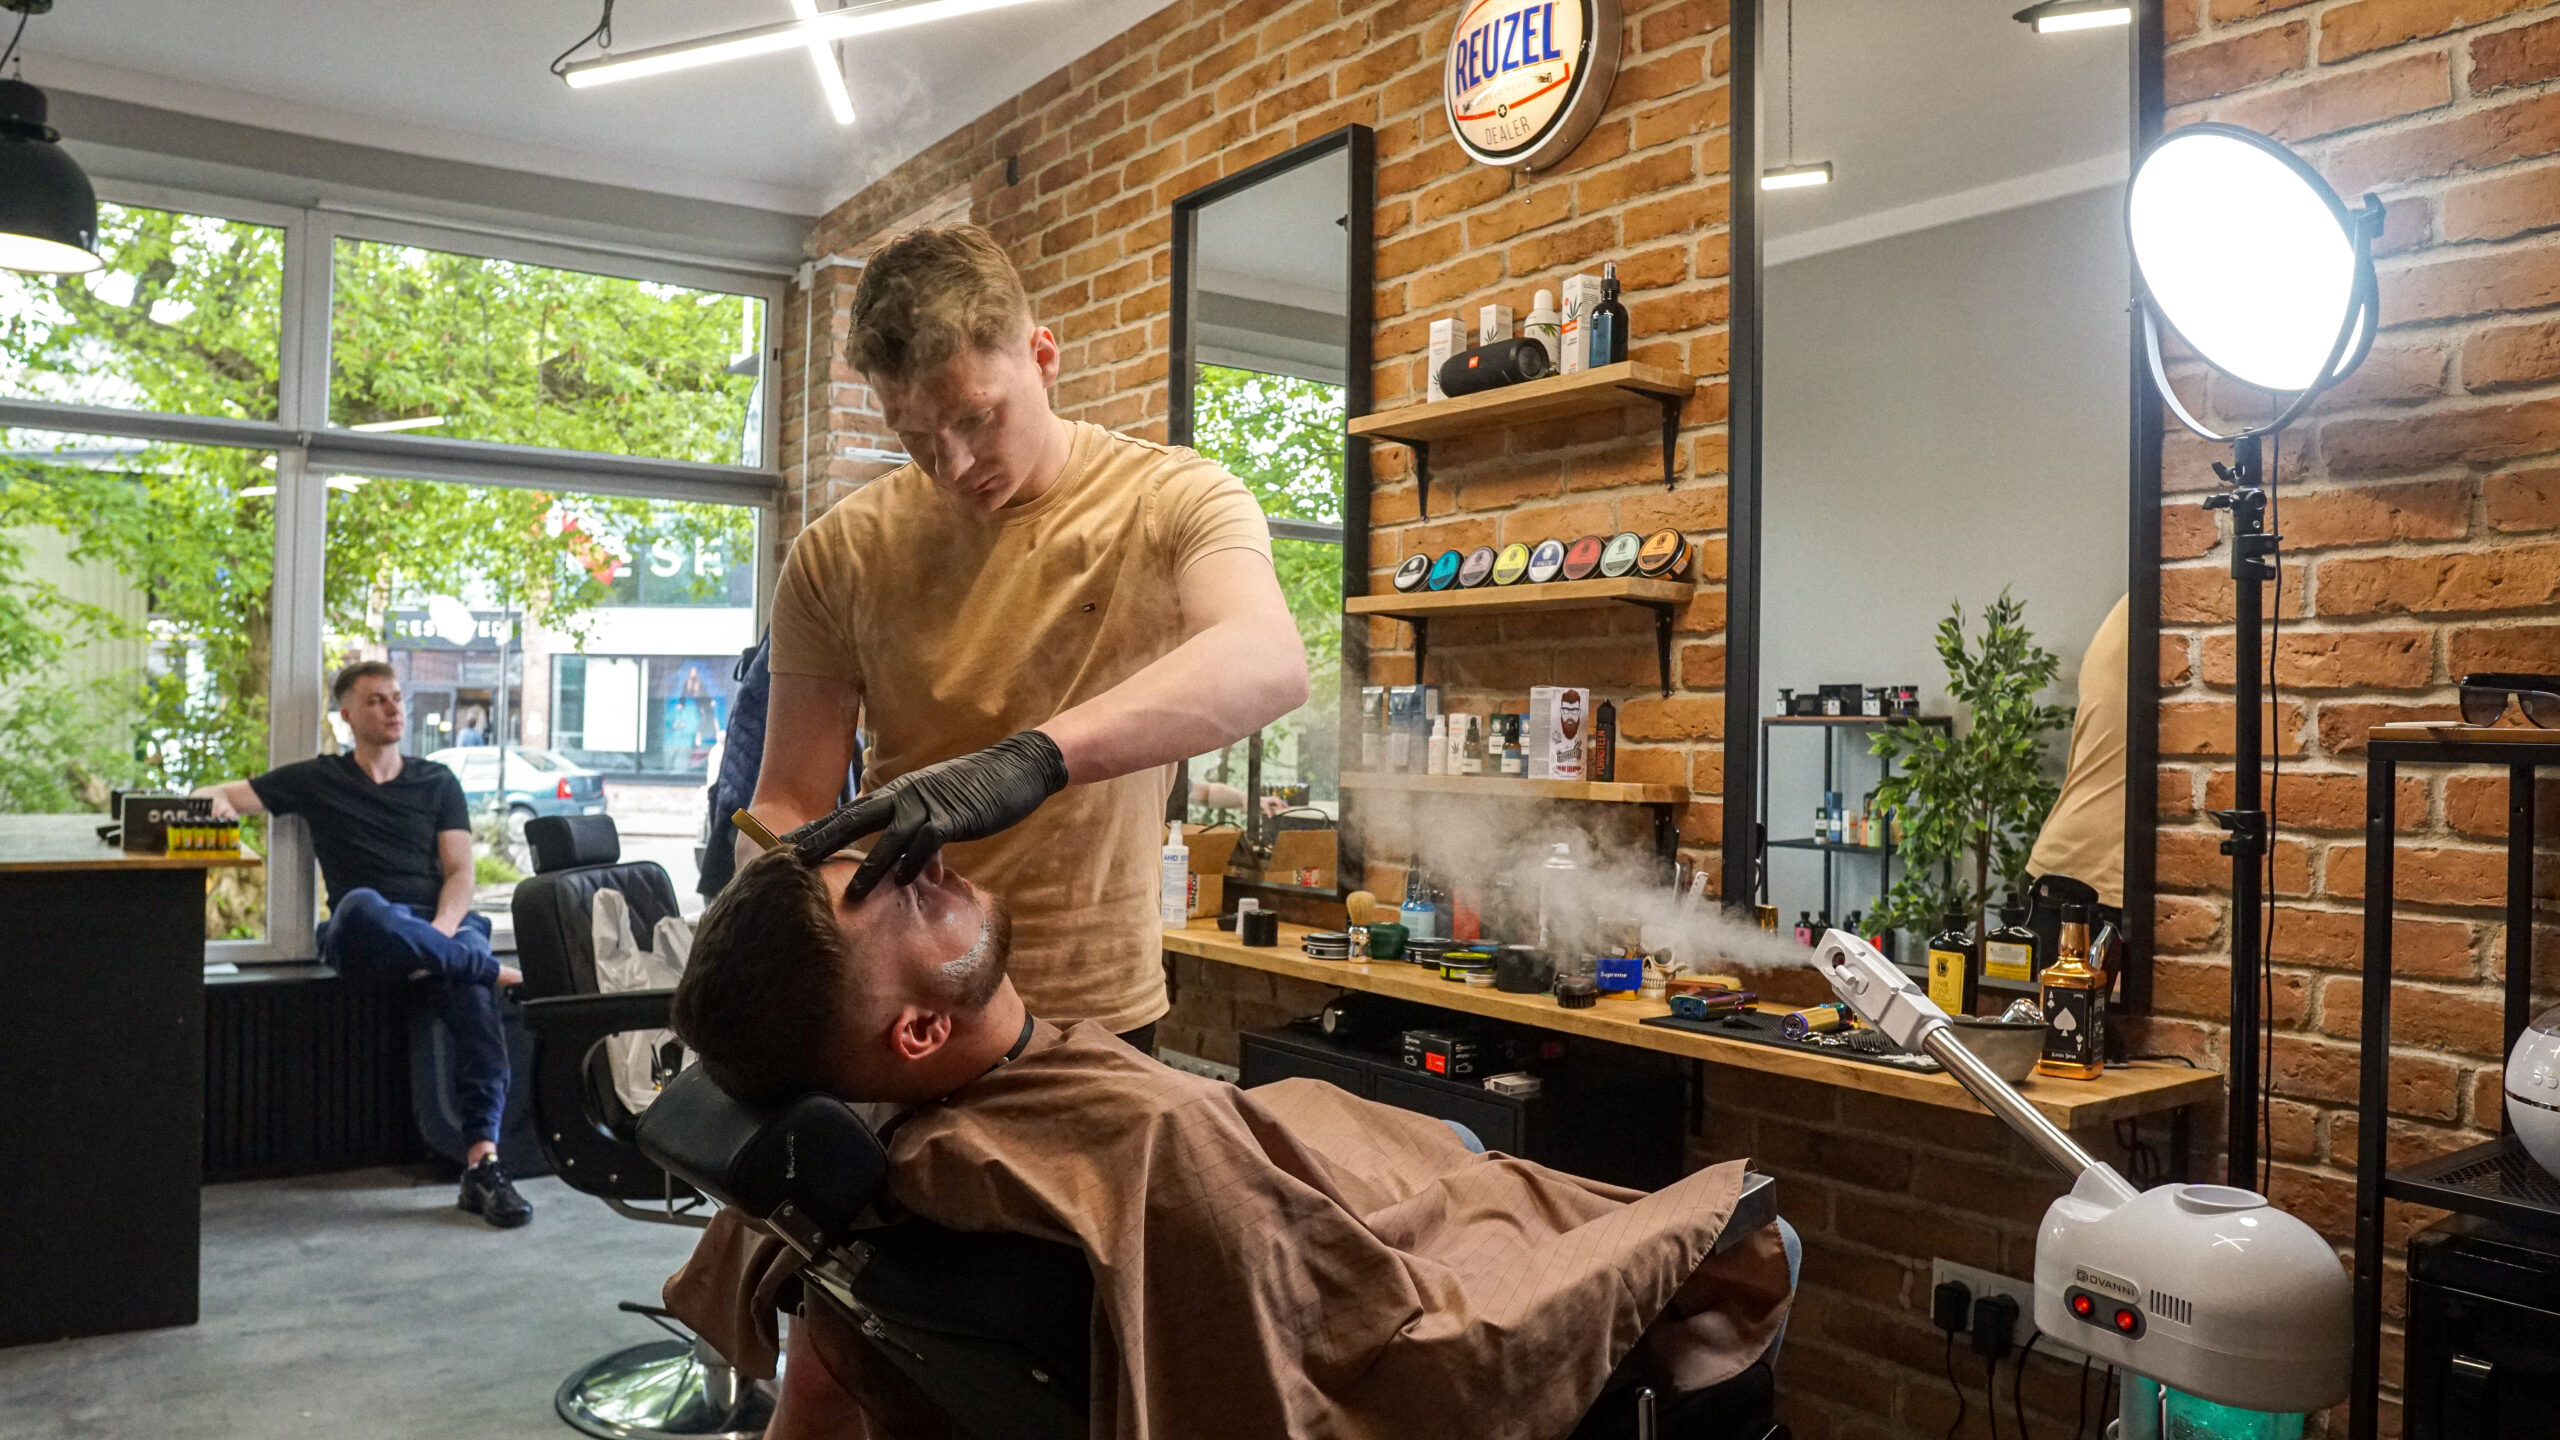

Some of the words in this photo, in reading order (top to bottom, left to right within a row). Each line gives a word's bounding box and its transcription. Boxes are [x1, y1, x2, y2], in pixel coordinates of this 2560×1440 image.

[1456, 2, 1561, 96] REUZEL
[1485, 116, 1531, 145] DEALER
[395, 619, 508, 638] RESED
[1600, 971, 1628, 979] Supreme
[2076, 1269, 2135, 1297] GIOVANNI
